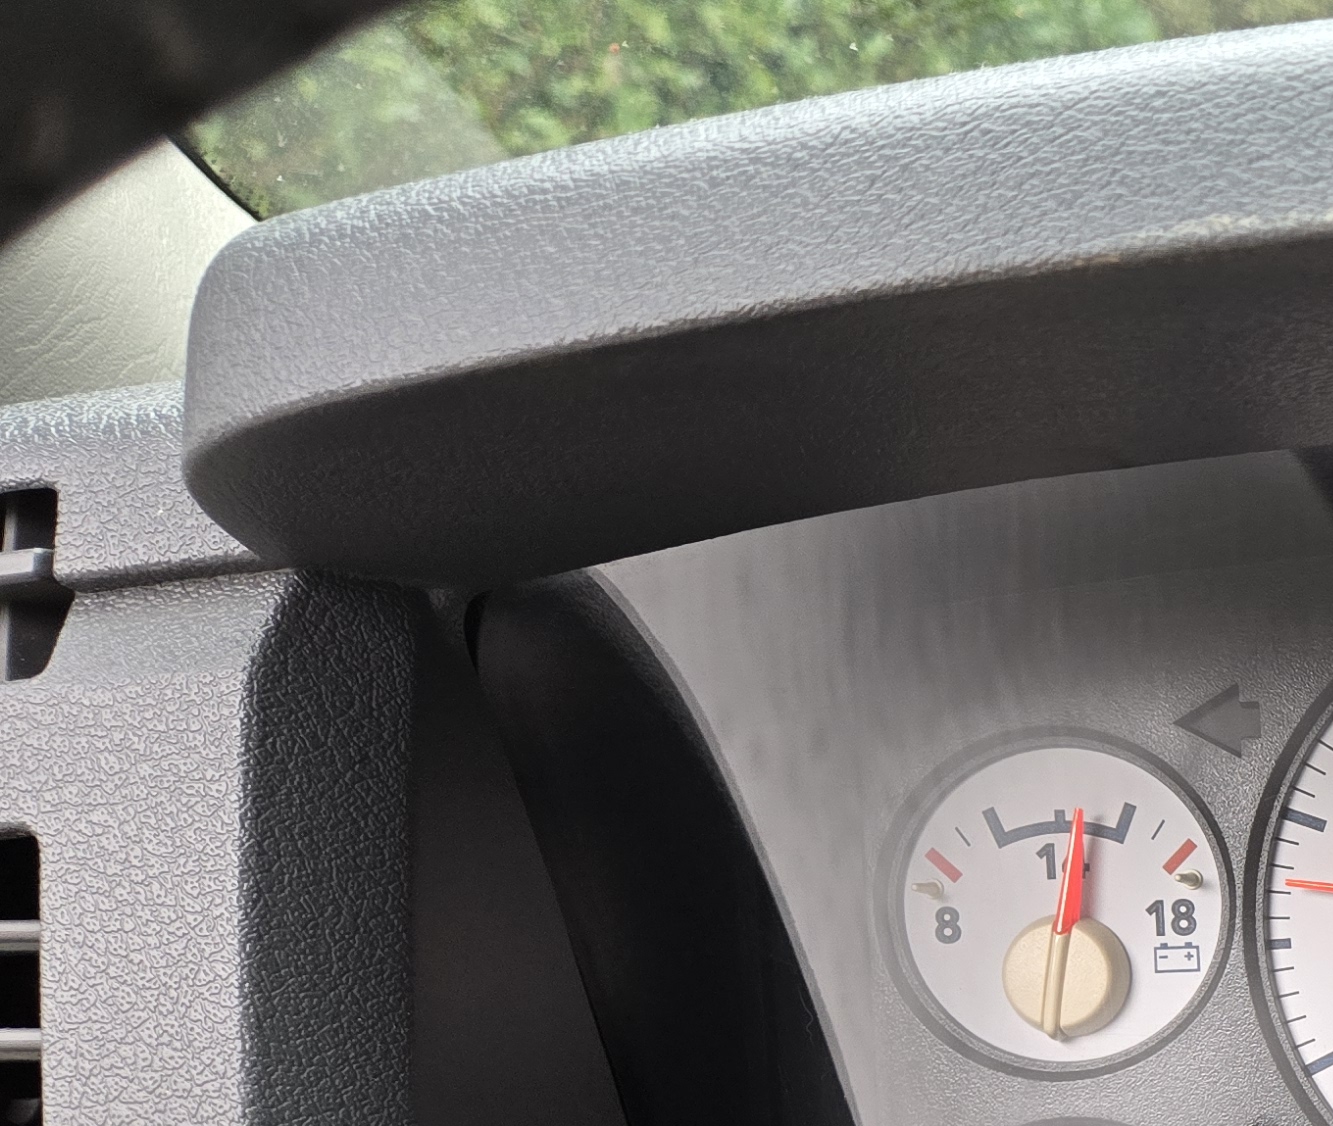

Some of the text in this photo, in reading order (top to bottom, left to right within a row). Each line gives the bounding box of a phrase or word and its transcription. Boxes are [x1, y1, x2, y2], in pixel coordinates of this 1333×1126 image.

[1035, 842, 1091, 880] 1
[934, 906, 962, 945] 8
[1145, 898, 1197, 937] 18
